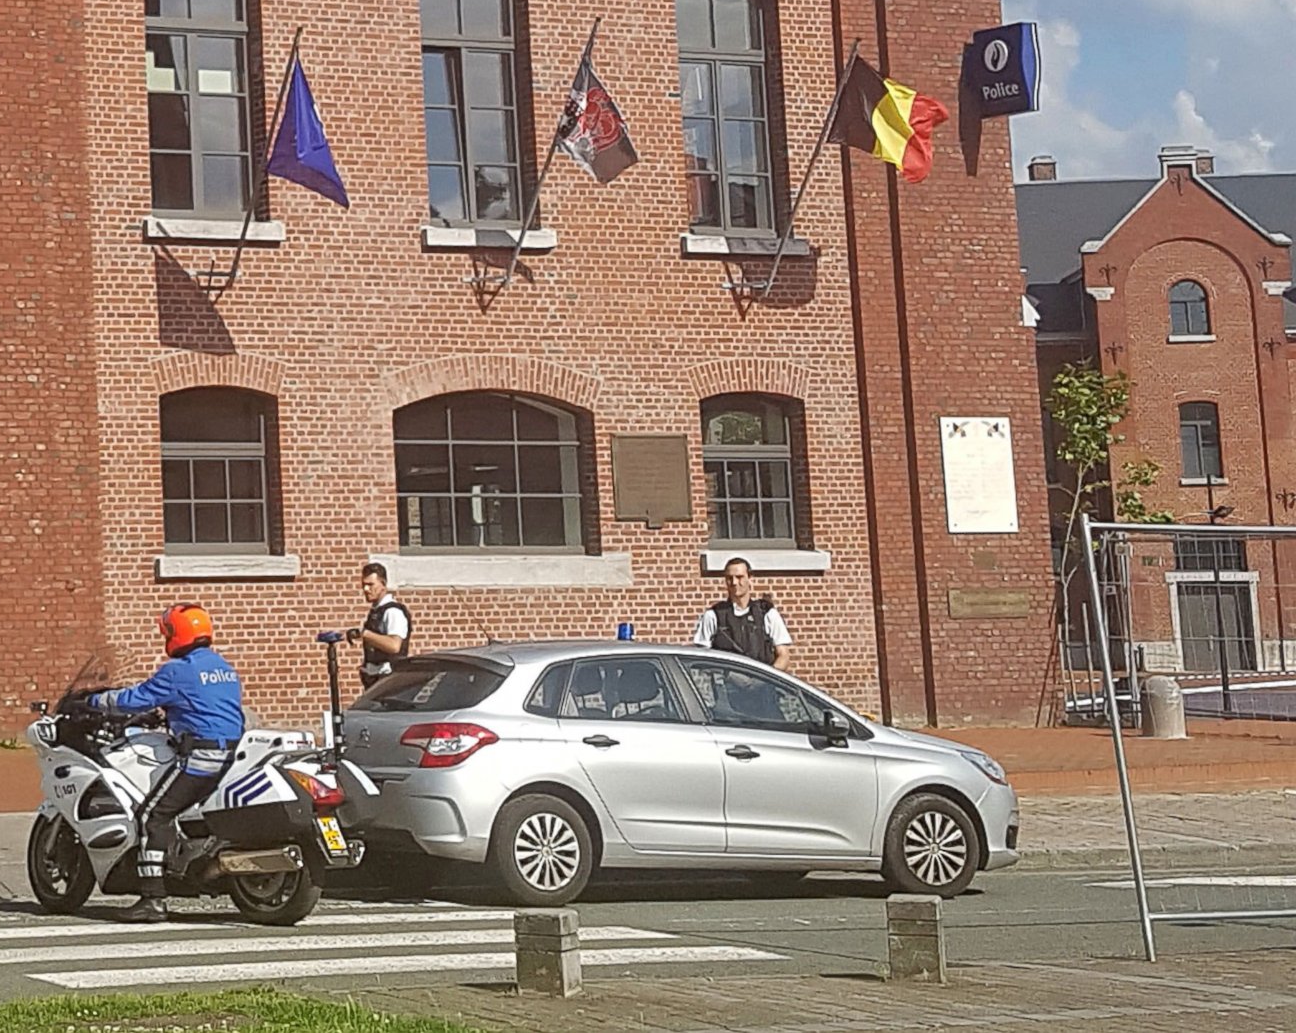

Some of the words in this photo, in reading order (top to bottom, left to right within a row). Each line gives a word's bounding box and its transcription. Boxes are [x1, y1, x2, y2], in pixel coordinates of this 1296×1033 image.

[982, 82, 1020, 100] Police
[199, 668, 238, 686] Police
[62, 783, 77, 795] 101
